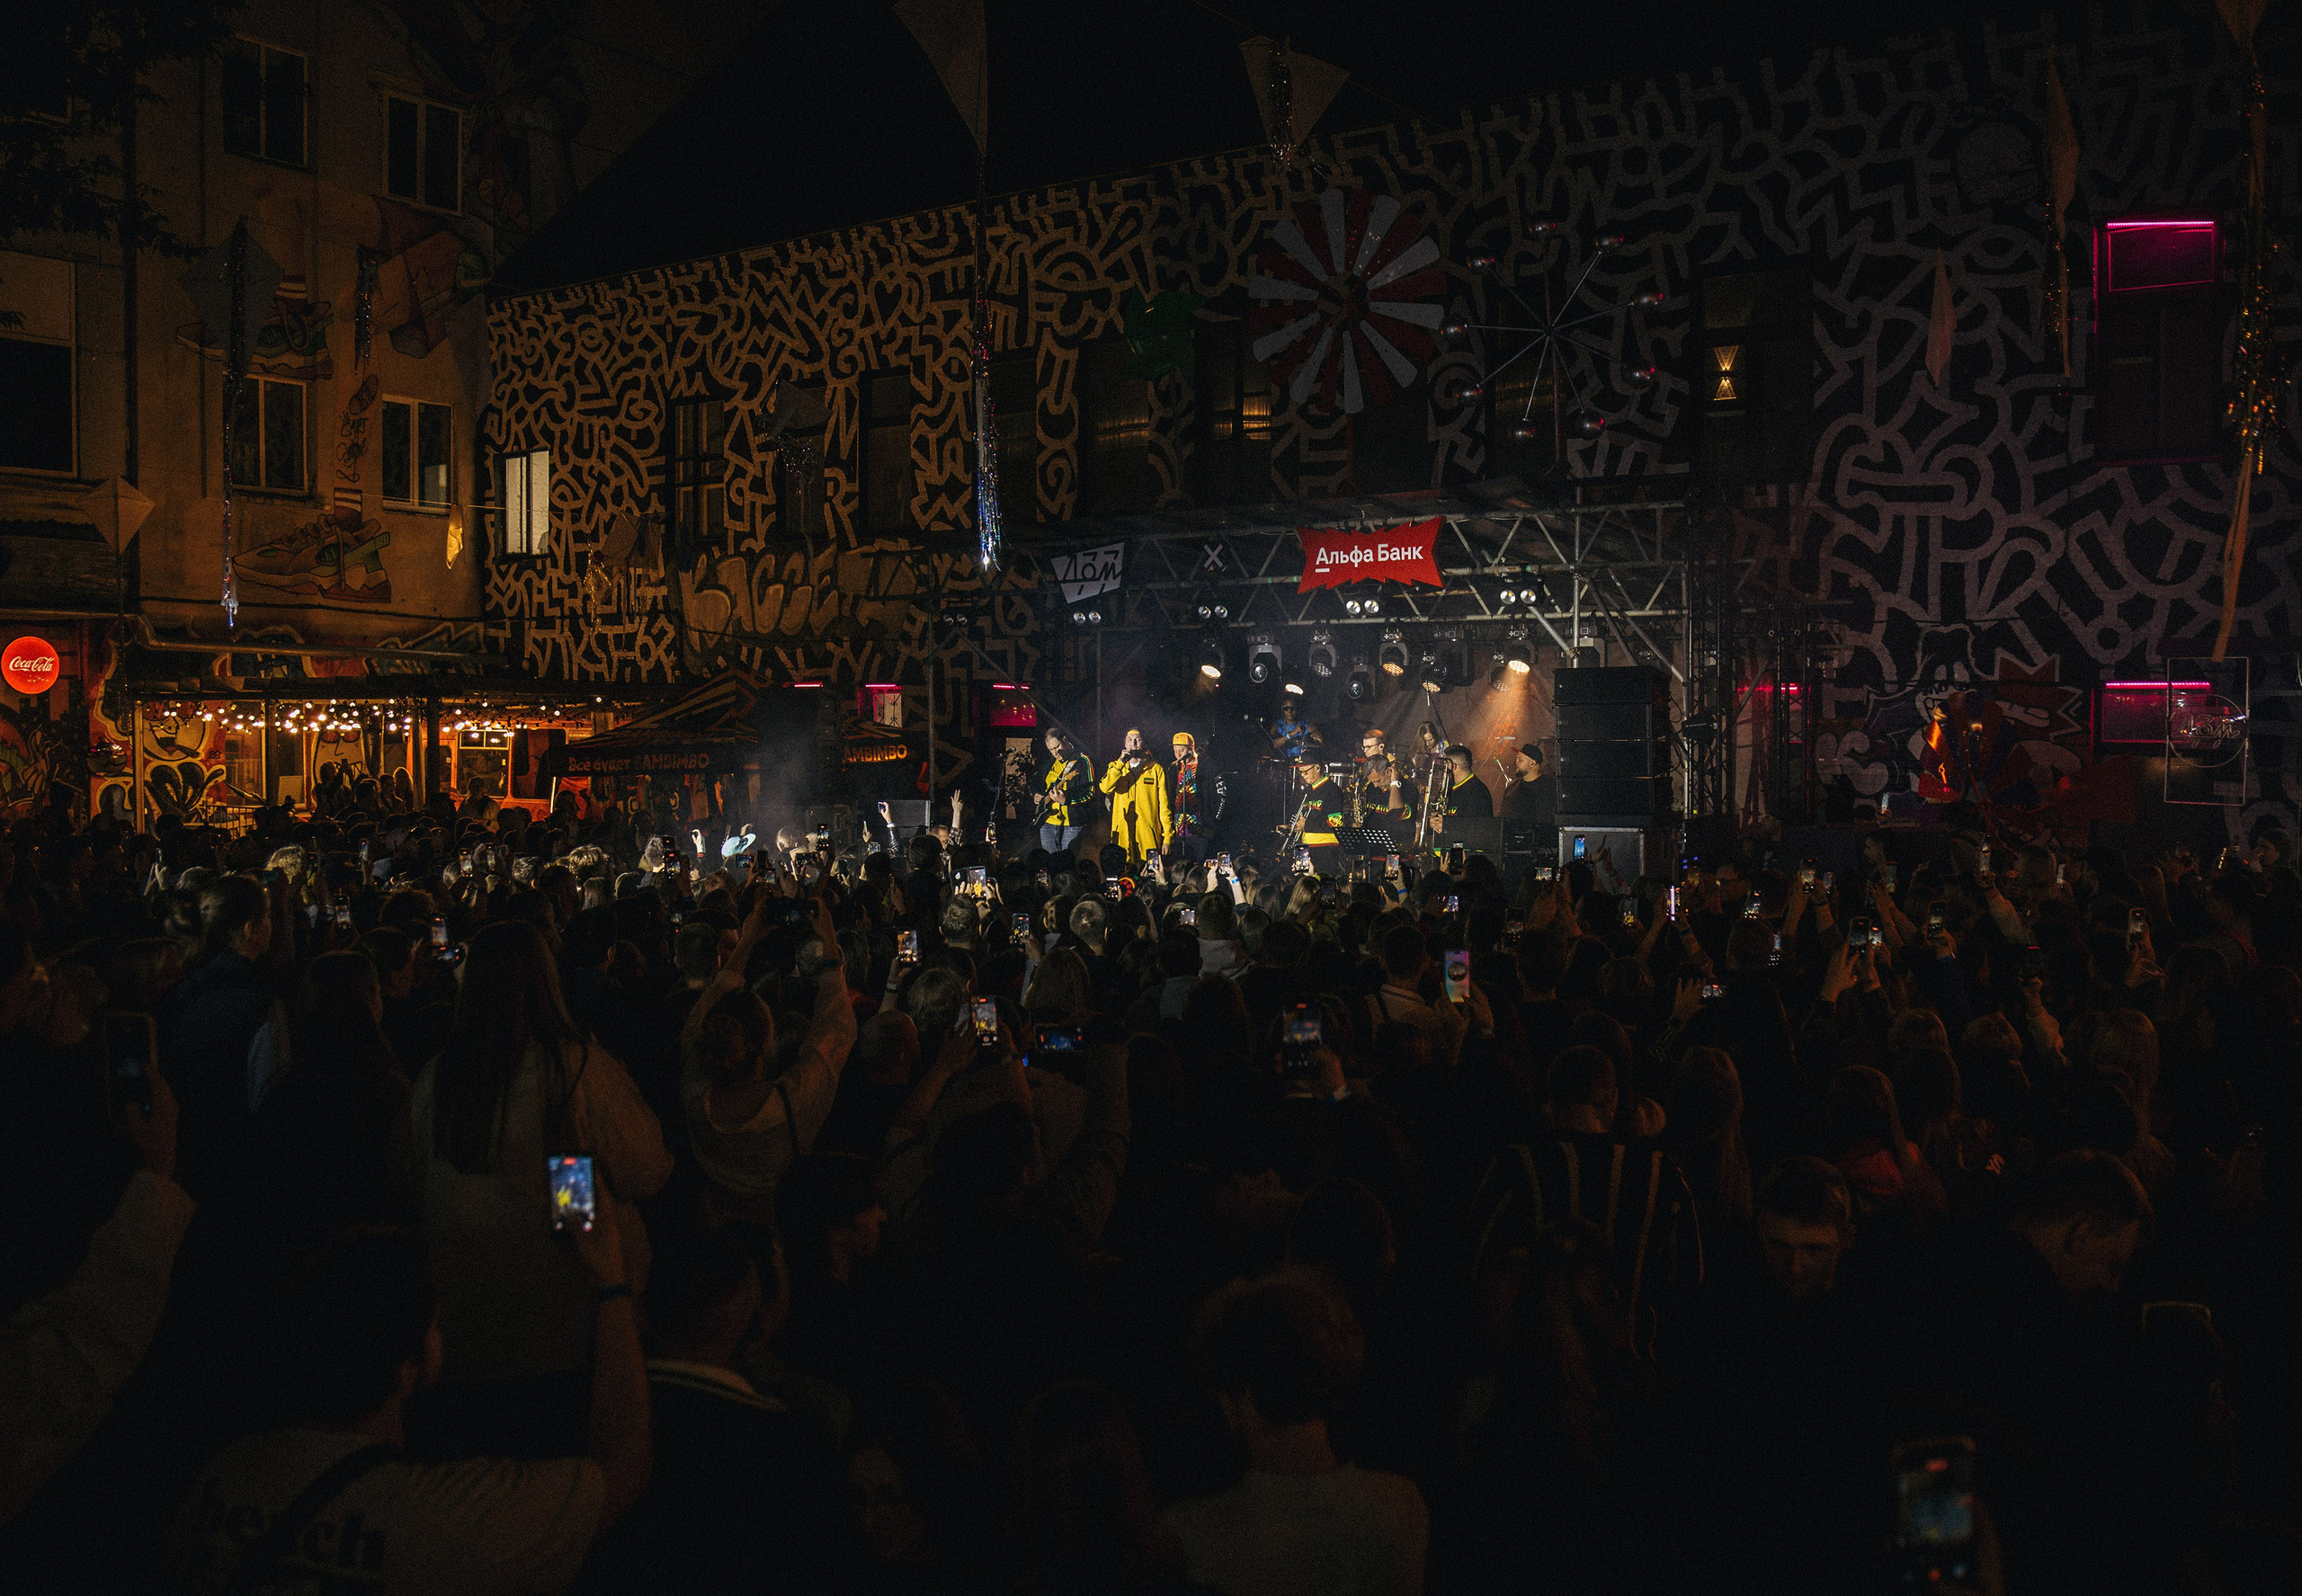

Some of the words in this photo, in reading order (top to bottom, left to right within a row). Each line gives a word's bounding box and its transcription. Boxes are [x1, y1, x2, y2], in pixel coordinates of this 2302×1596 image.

[1315, 545, 1374, 568] Альфа
[1378, 543, 1423, 562] Банк
[9, 656, 55, 673] Coca-Cola
[843, 744, 907, 762] AMBIMBO
[192, 1479, 385, 1572] bech
